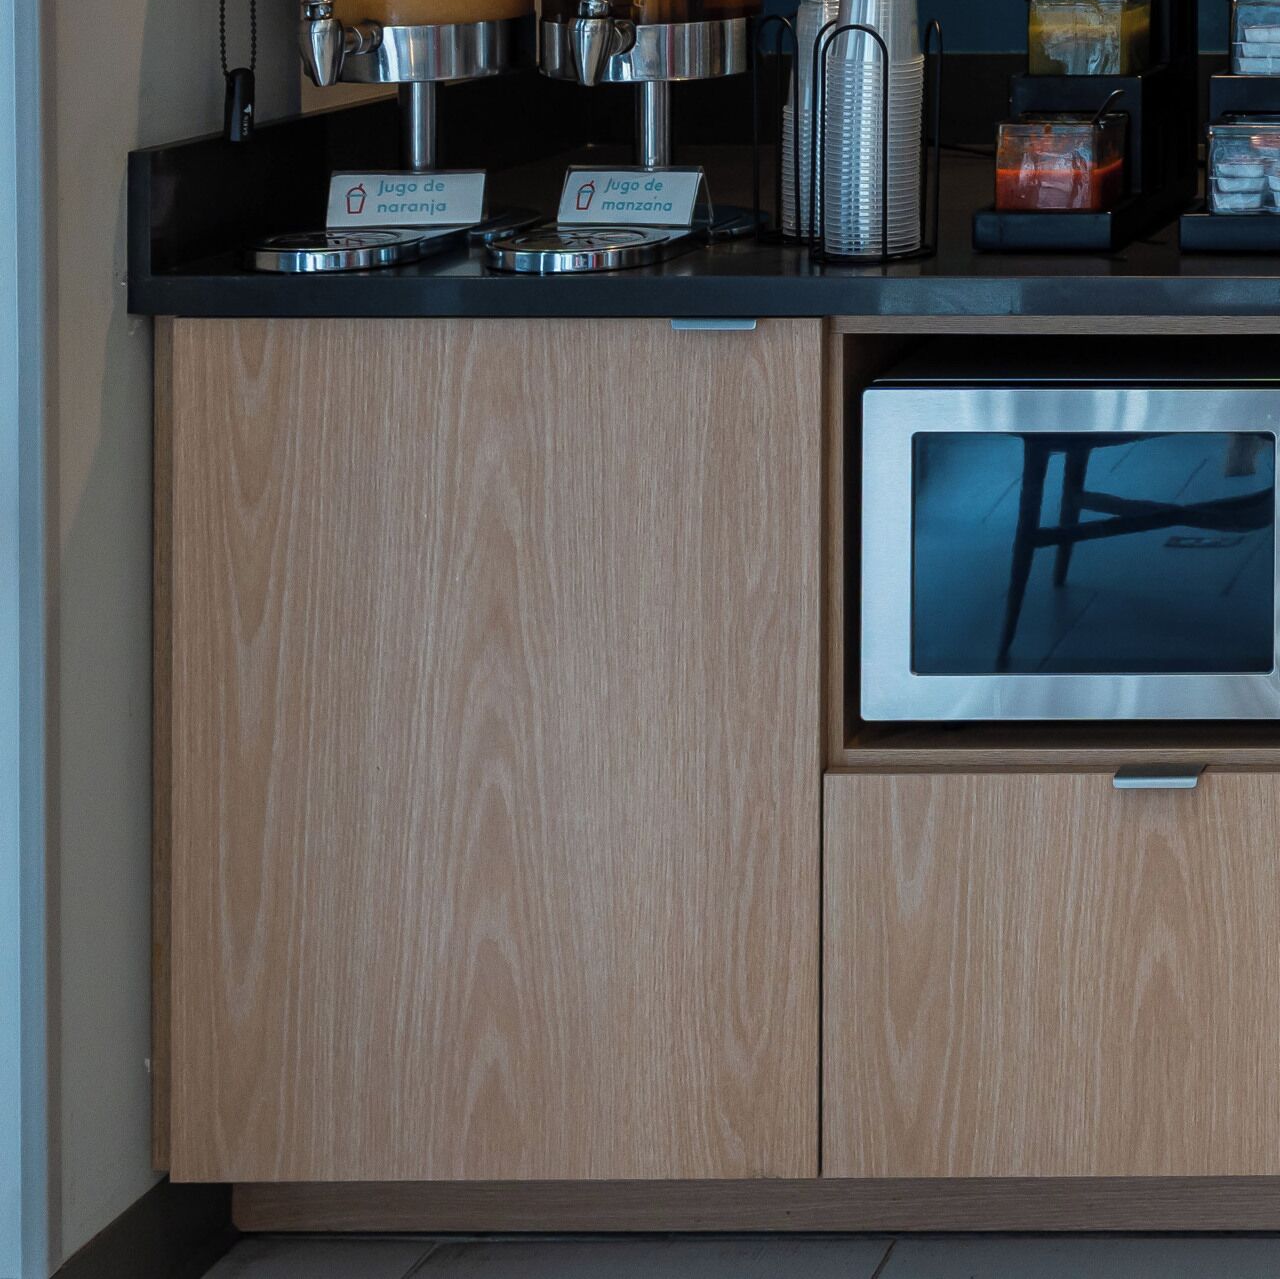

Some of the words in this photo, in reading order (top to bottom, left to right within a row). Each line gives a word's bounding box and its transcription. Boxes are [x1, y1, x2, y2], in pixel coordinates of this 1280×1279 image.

[377, 179, 418, 196] Jugo
[423, 178, 446, 193] de
[604, 177, 640, 194] Jugo
[643, 177, 664, 191] de
[377, 199, 447, 215] naranja
[601, 198, 673, 213] manzana
